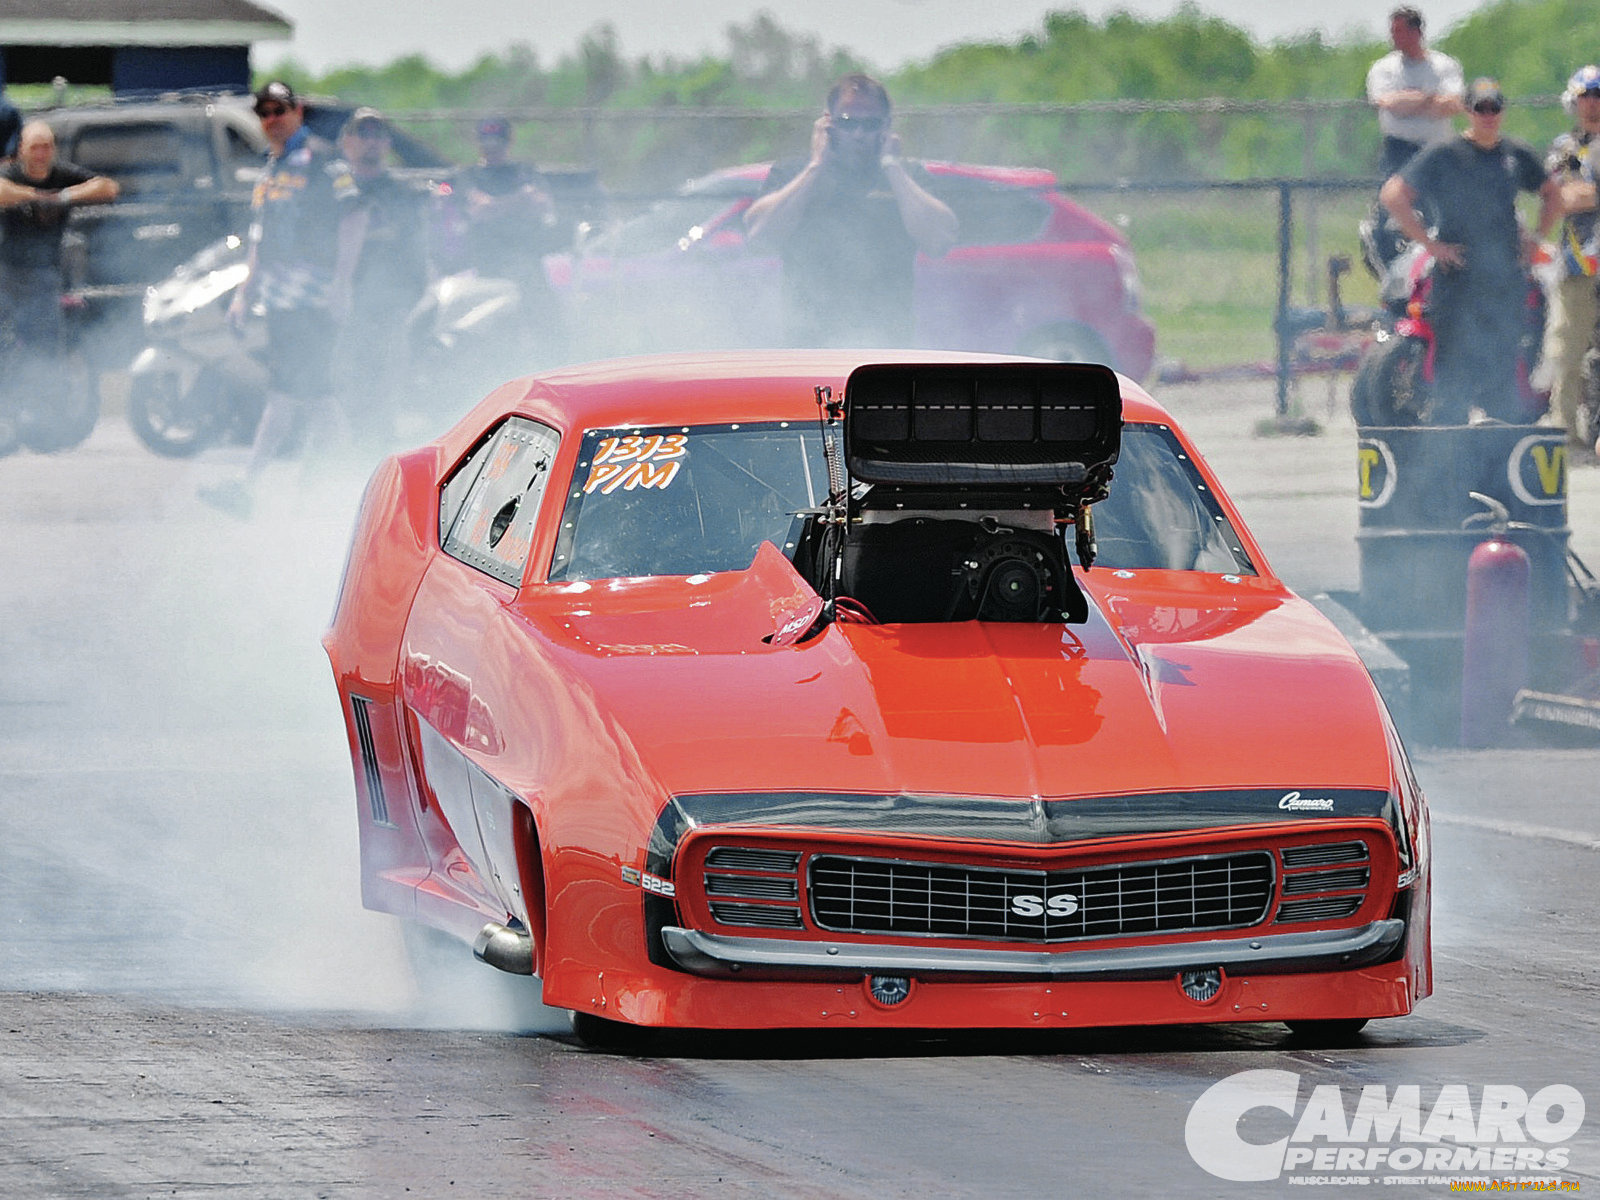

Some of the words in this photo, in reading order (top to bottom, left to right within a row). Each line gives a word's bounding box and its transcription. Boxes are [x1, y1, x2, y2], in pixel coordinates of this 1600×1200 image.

[593, 435, 688, 465] 1313
[583, 462, 680, 494] P/M
[1278, 791, 1334, 809] Camaro
[642, 873, 676, 897] 522
[1011, 894, 1078, 917] SS
